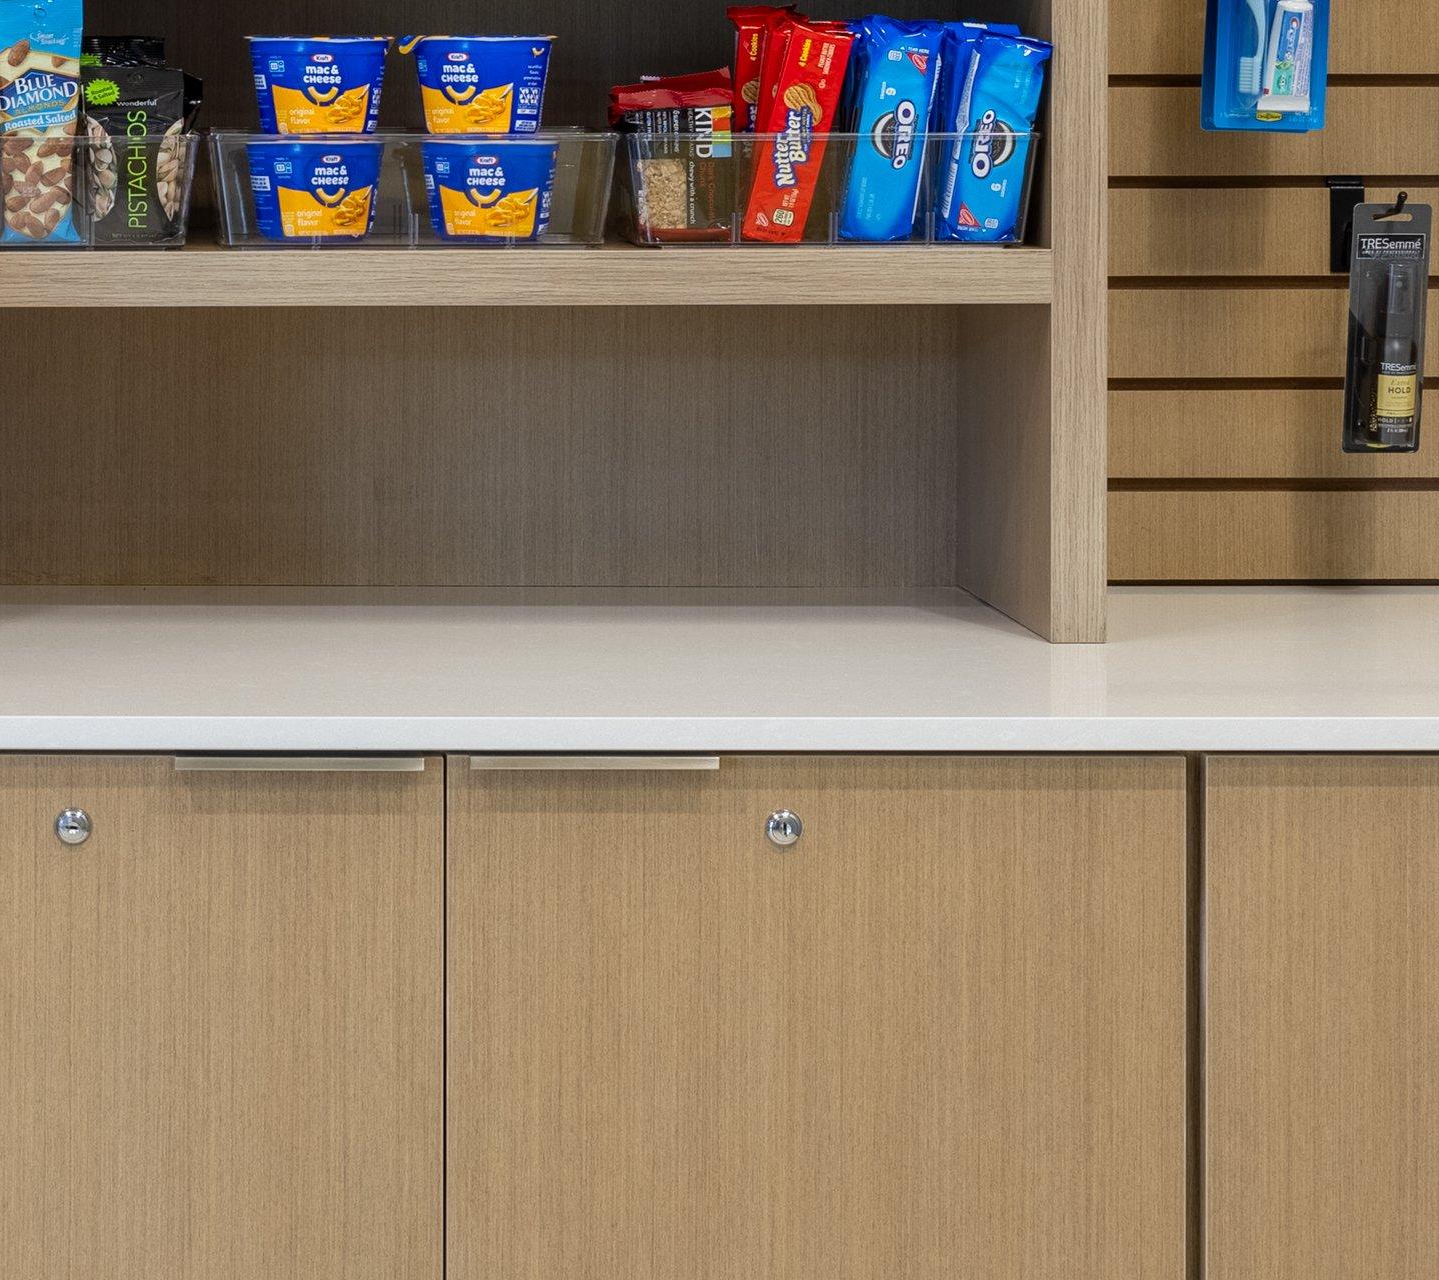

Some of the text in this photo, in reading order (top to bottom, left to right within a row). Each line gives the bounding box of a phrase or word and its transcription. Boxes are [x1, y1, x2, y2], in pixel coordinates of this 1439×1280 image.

[15, 75, 55, 95] BLUE
[306, 65, 338, 74] mac &
[3, 112, 76, 133] Roasted Salted
[695, 107, 713, 158] KIND
[892, 100, 915, 170] OREO
[970, 108, 996, 179] OREO
[128, 110, 147, 229] PISTACHIOS
[1360, 237, 1421, 250] TRESemmé
